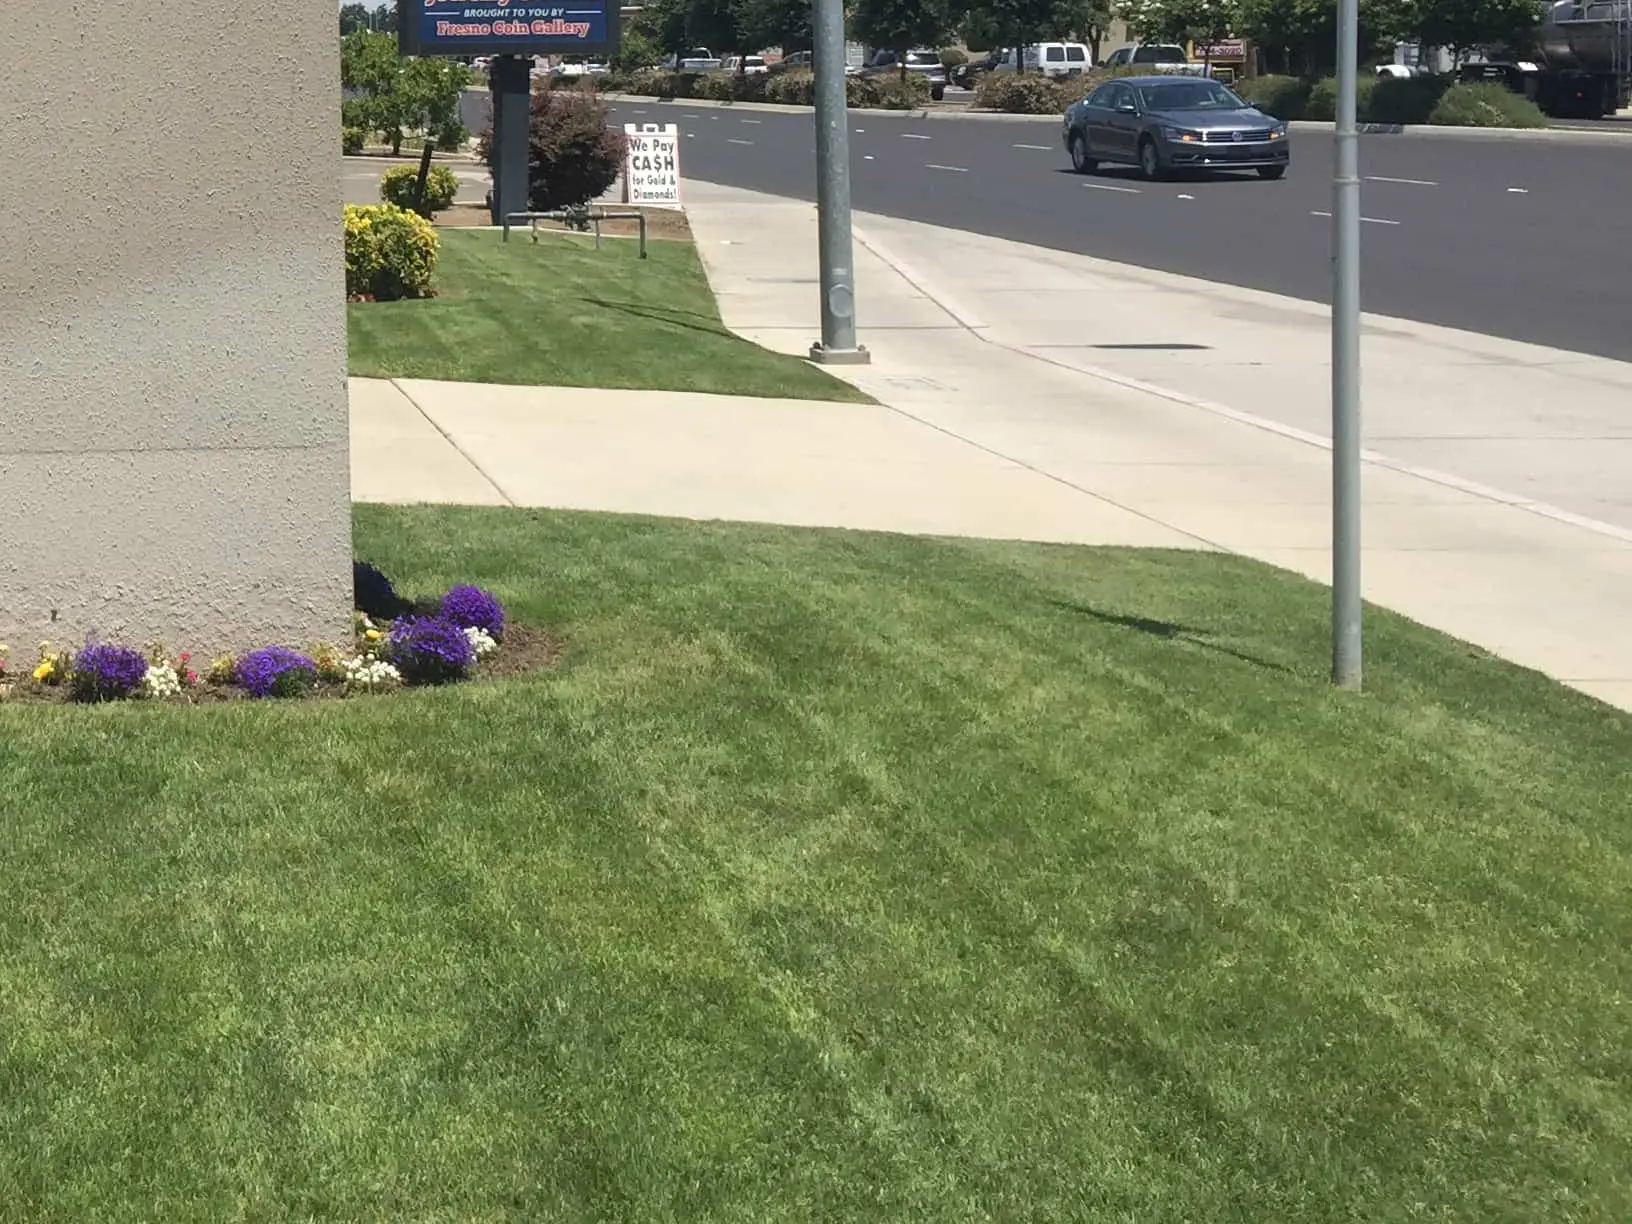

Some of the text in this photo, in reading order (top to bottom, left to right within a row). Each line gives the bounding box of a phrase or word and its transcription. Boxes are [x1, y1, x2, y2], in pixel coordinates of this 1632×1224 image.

[464, 8, 564, 18] BROUGHT TO YOU BY
[437, 19, 590, 38] Fresno Coin Gallery
[630, 138, 674, 155] We Pay
[632, 154, 674, 172] CA$H
[632, 174, 644, 185] for
[647, 174, 666, 185] Gold
